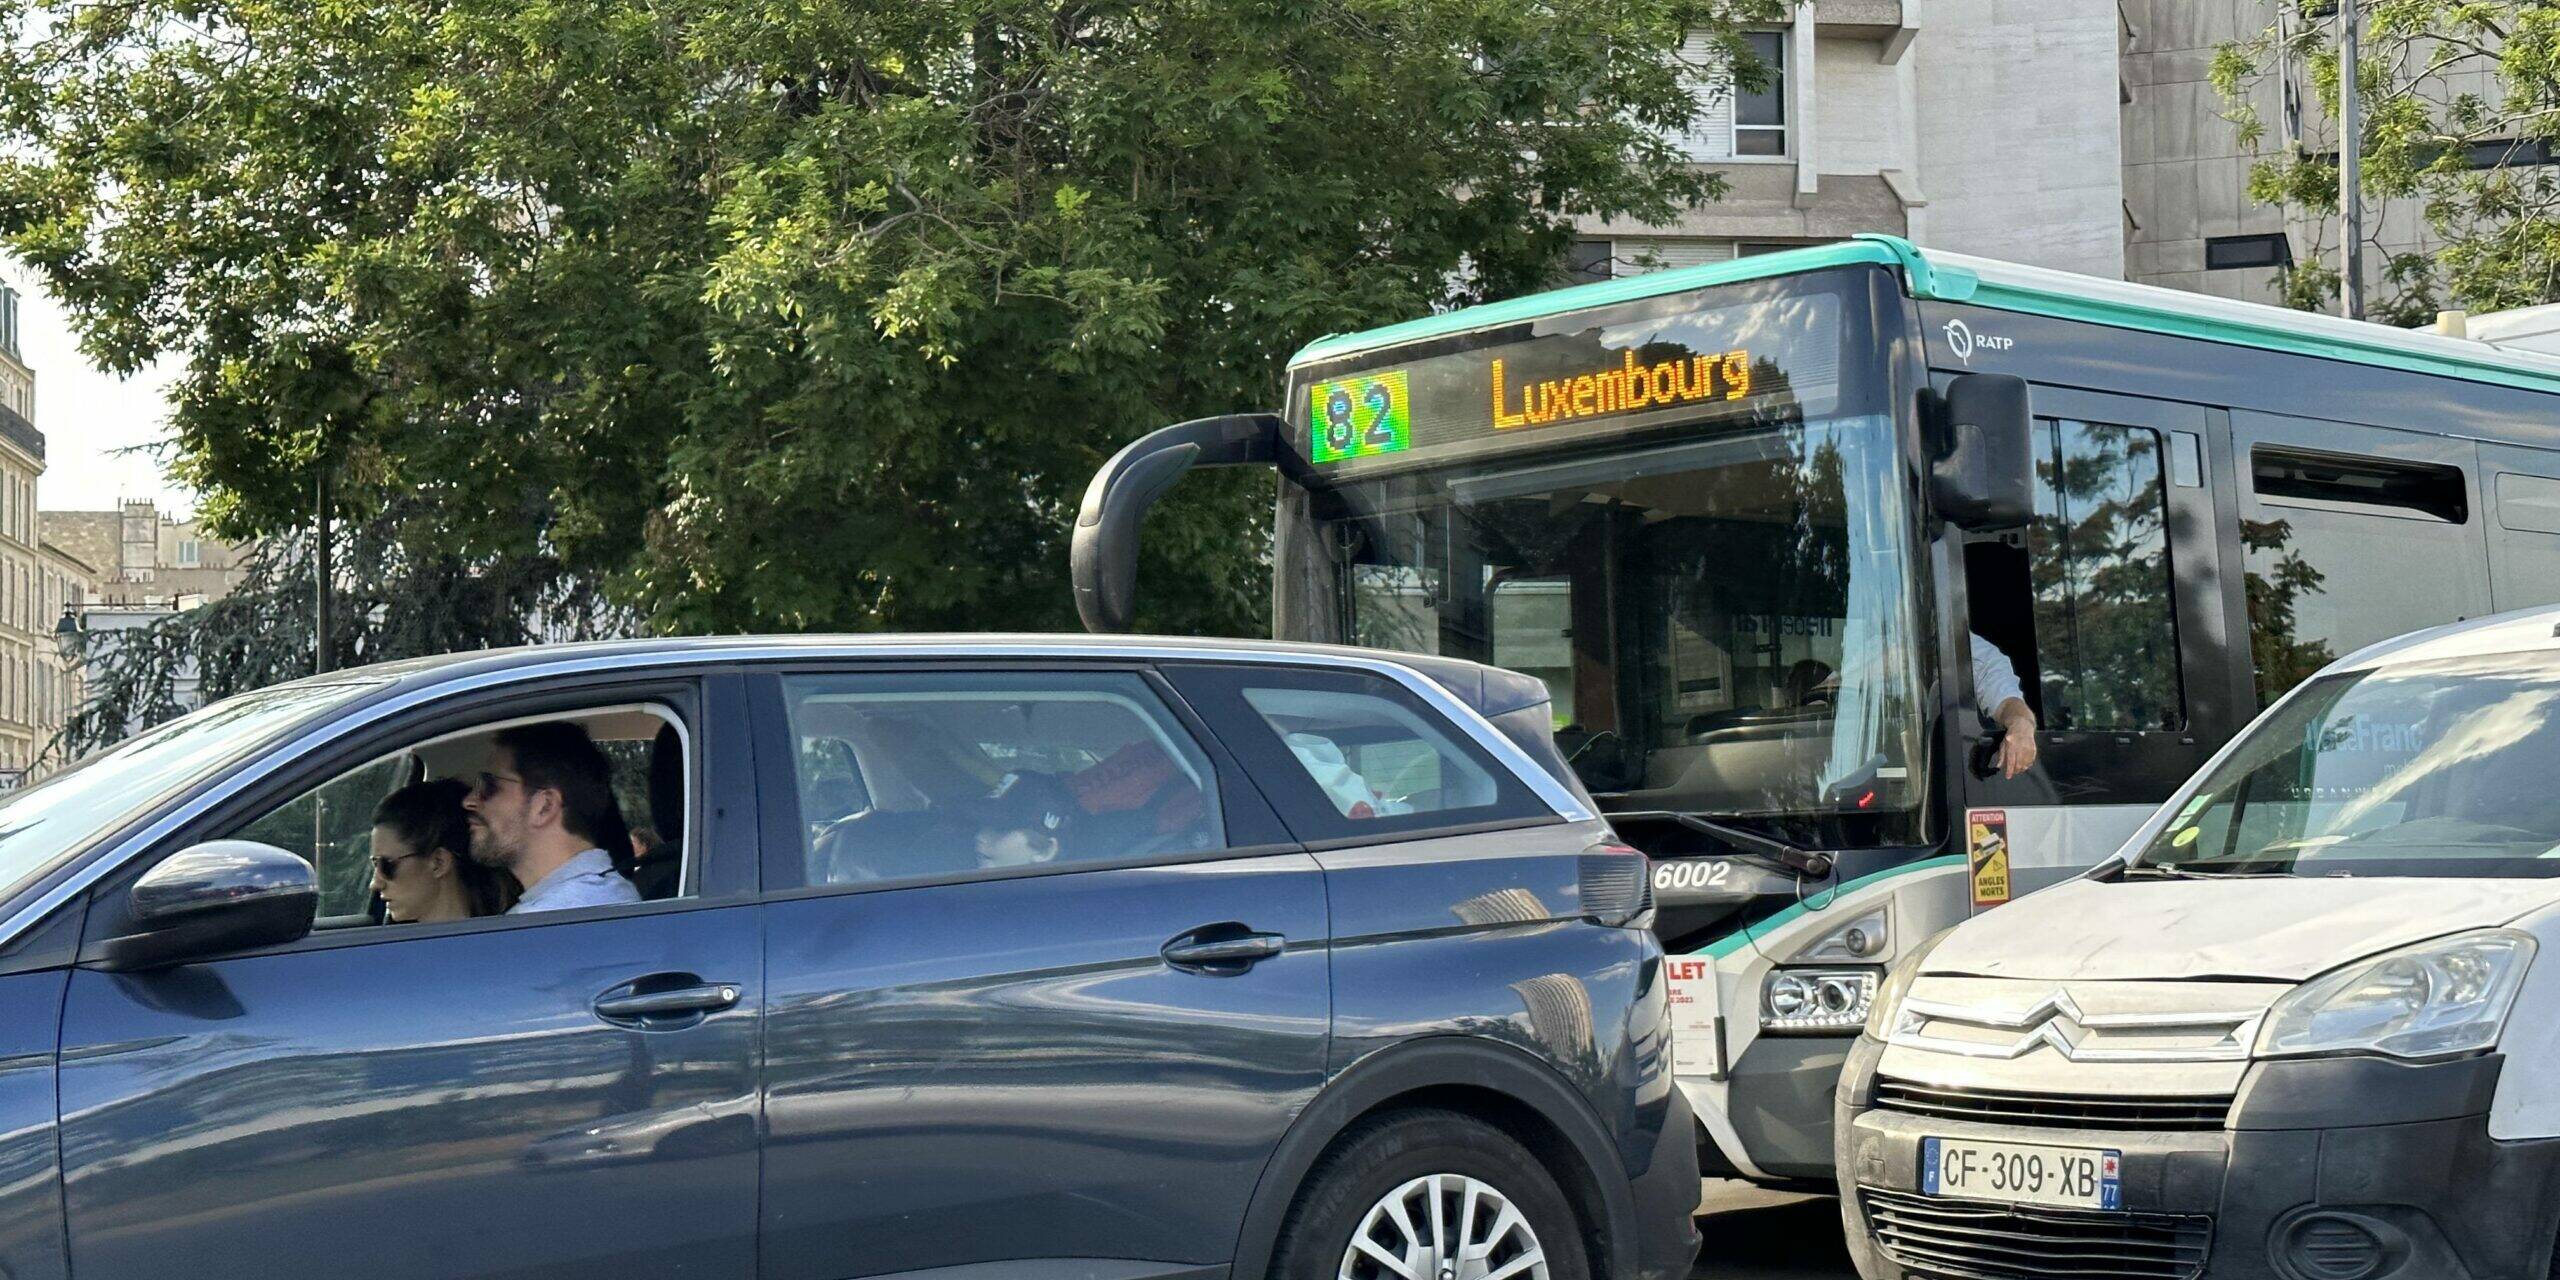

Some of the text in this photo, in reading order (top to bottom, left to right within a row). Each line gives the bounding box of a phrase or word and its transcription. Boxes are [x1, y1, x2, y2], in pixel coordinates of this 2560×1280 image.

[1976, 335, 2013, 350] RATP
[1492, 350, 1749, 429] Luxembourg
[1327, 384, 1391, 450] 82
[1972, 813, 2004, 823] ATTENTION
[1654, 861, 1731, 890] 6002
[1979, 876, 2005, 887] ANGLES
[1980, 887, 2005, 897] MORTS
[1666, 962, 1706, 980] LET
[1929, 1149, 2095, 1197] F CF-309-XB
[2103, 1184, 2118, 1201] 77
